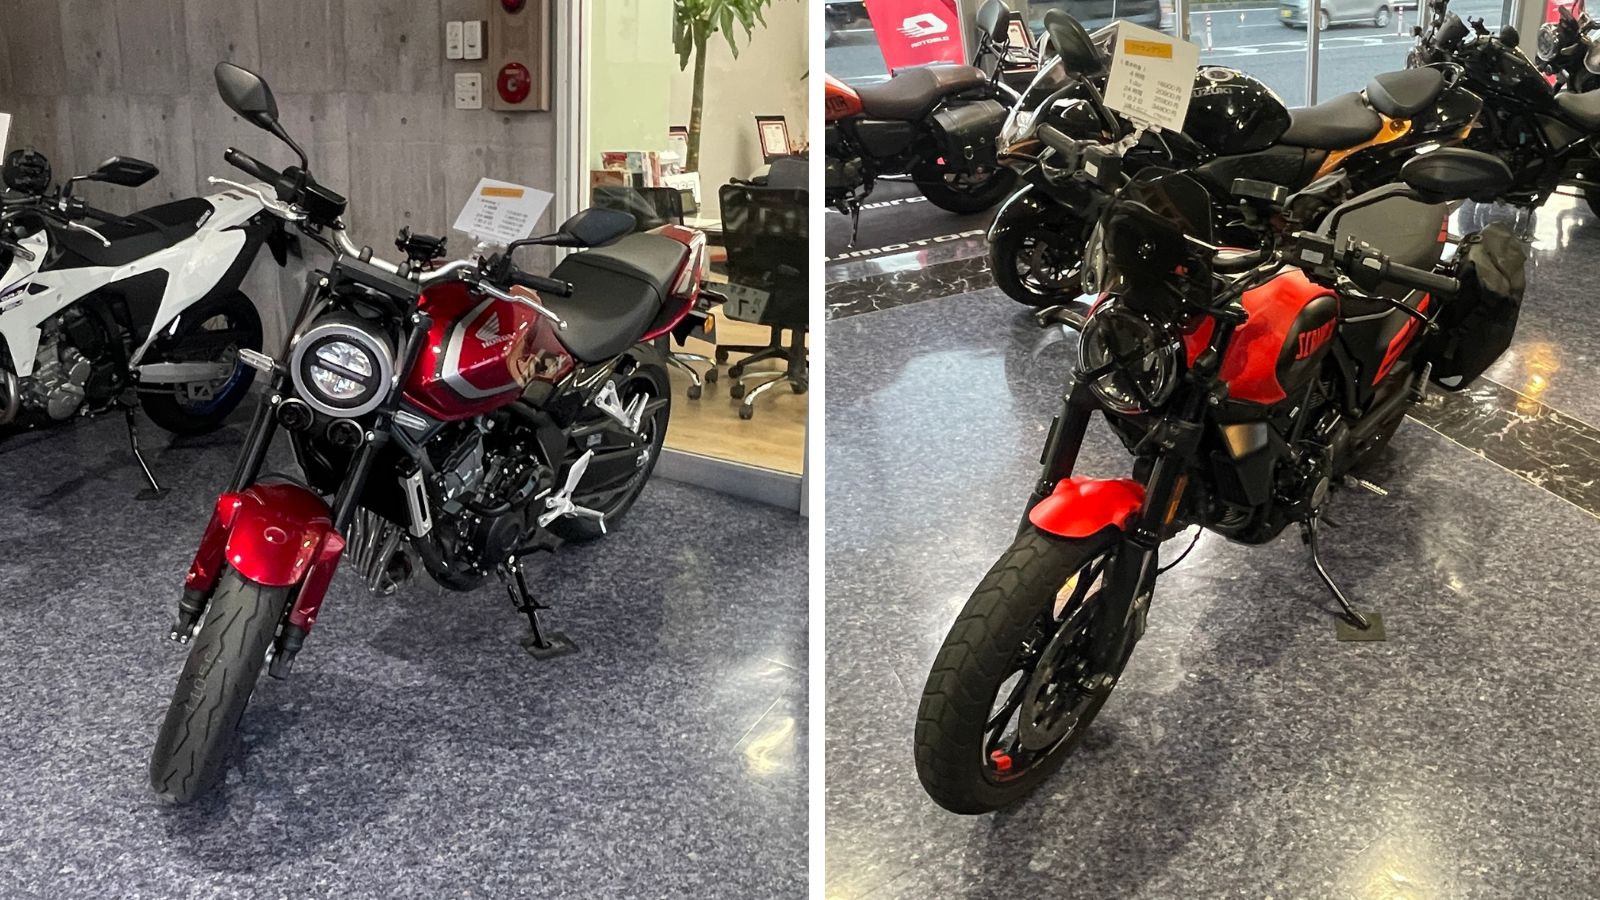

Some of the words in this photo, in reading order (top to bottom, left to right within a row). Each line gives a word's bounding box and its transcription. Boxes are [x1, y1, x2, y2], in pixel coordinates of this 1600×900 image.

[1192, 87, 1233, 98] UZUKI
[825, 229, 987, 262] JMOTOR
[481, 333, 514, 349] HONDA
